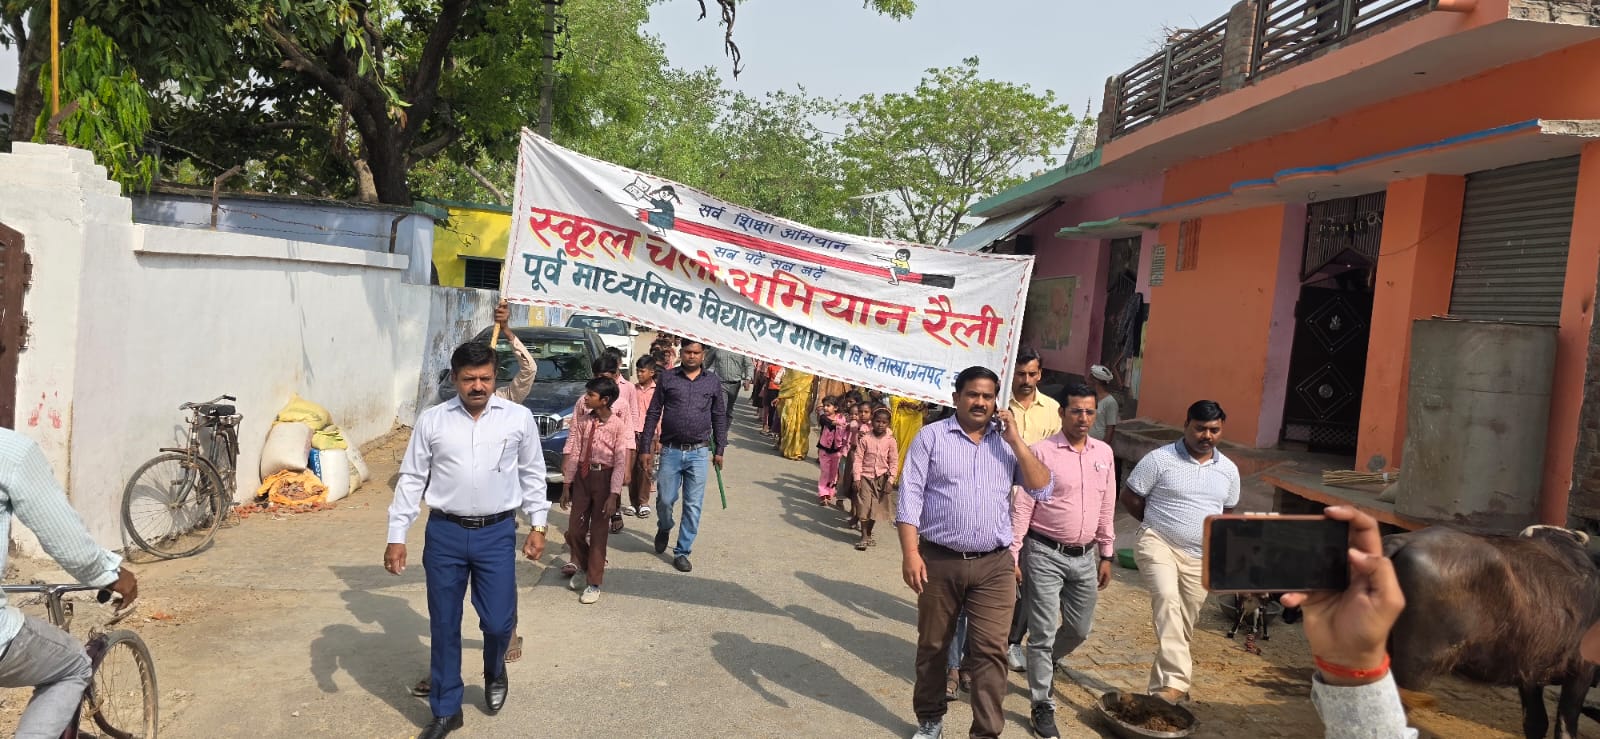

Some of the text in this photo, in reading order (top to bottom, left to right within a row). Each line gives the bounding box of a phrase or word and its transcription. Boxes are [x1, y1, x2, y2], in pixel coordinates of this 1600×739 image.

[699, 203, 726, 221] सर्व
[780, 227, 849, 253] अभियान
[714, 246, 740, 262] सब
[770, 258, 796, 273] सब
[522, 247, 568, 294] पूर्व
[572, 261, 697, 315] माध्यमिक
[698, 287, 790, 343] विद्यालय
[529, 206, 642, 260] स्कूल
[726, 269, 916, 336] अभियान
[922, 294, 1004, 348] रैली
